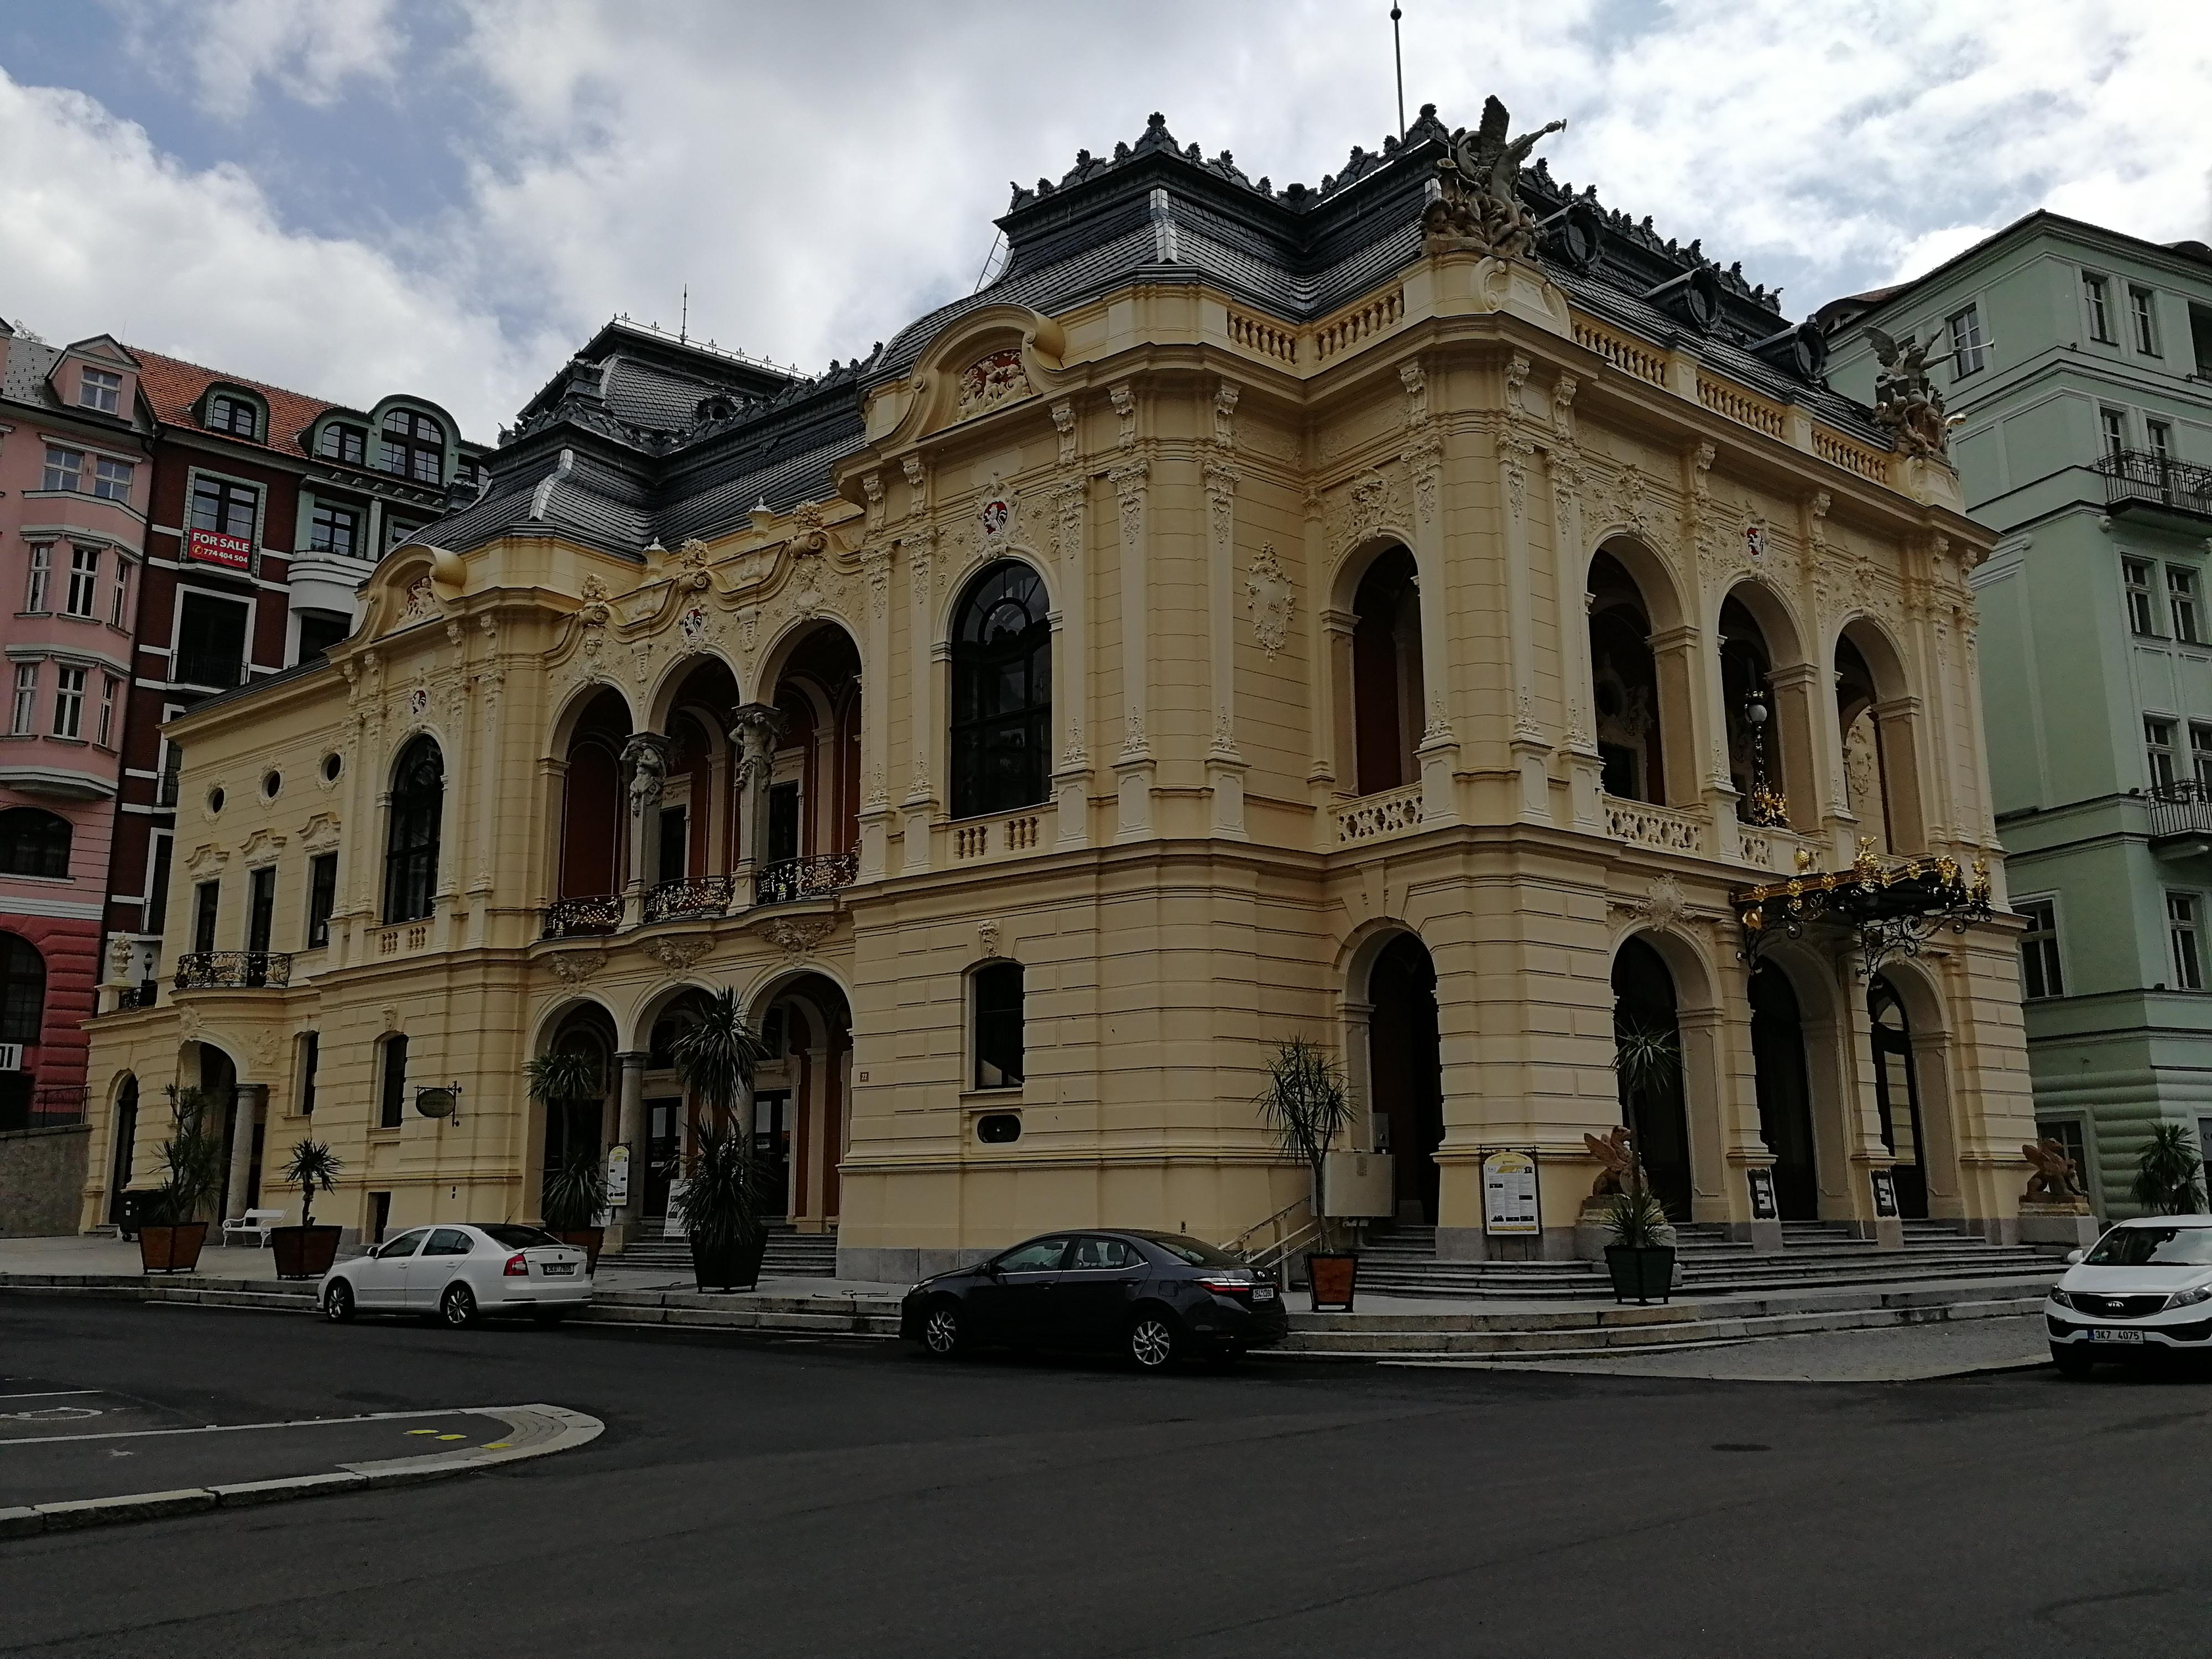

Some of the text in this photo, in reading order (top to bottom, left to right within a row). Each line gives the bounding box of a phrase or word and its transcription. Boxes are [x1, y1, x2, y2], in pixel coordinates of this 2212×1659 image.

[193, 533, 249, 552] FOR SALE
[204, 548, 218, 556] 774
[2095, 1331, 2139, 1340] 3K7 4075
